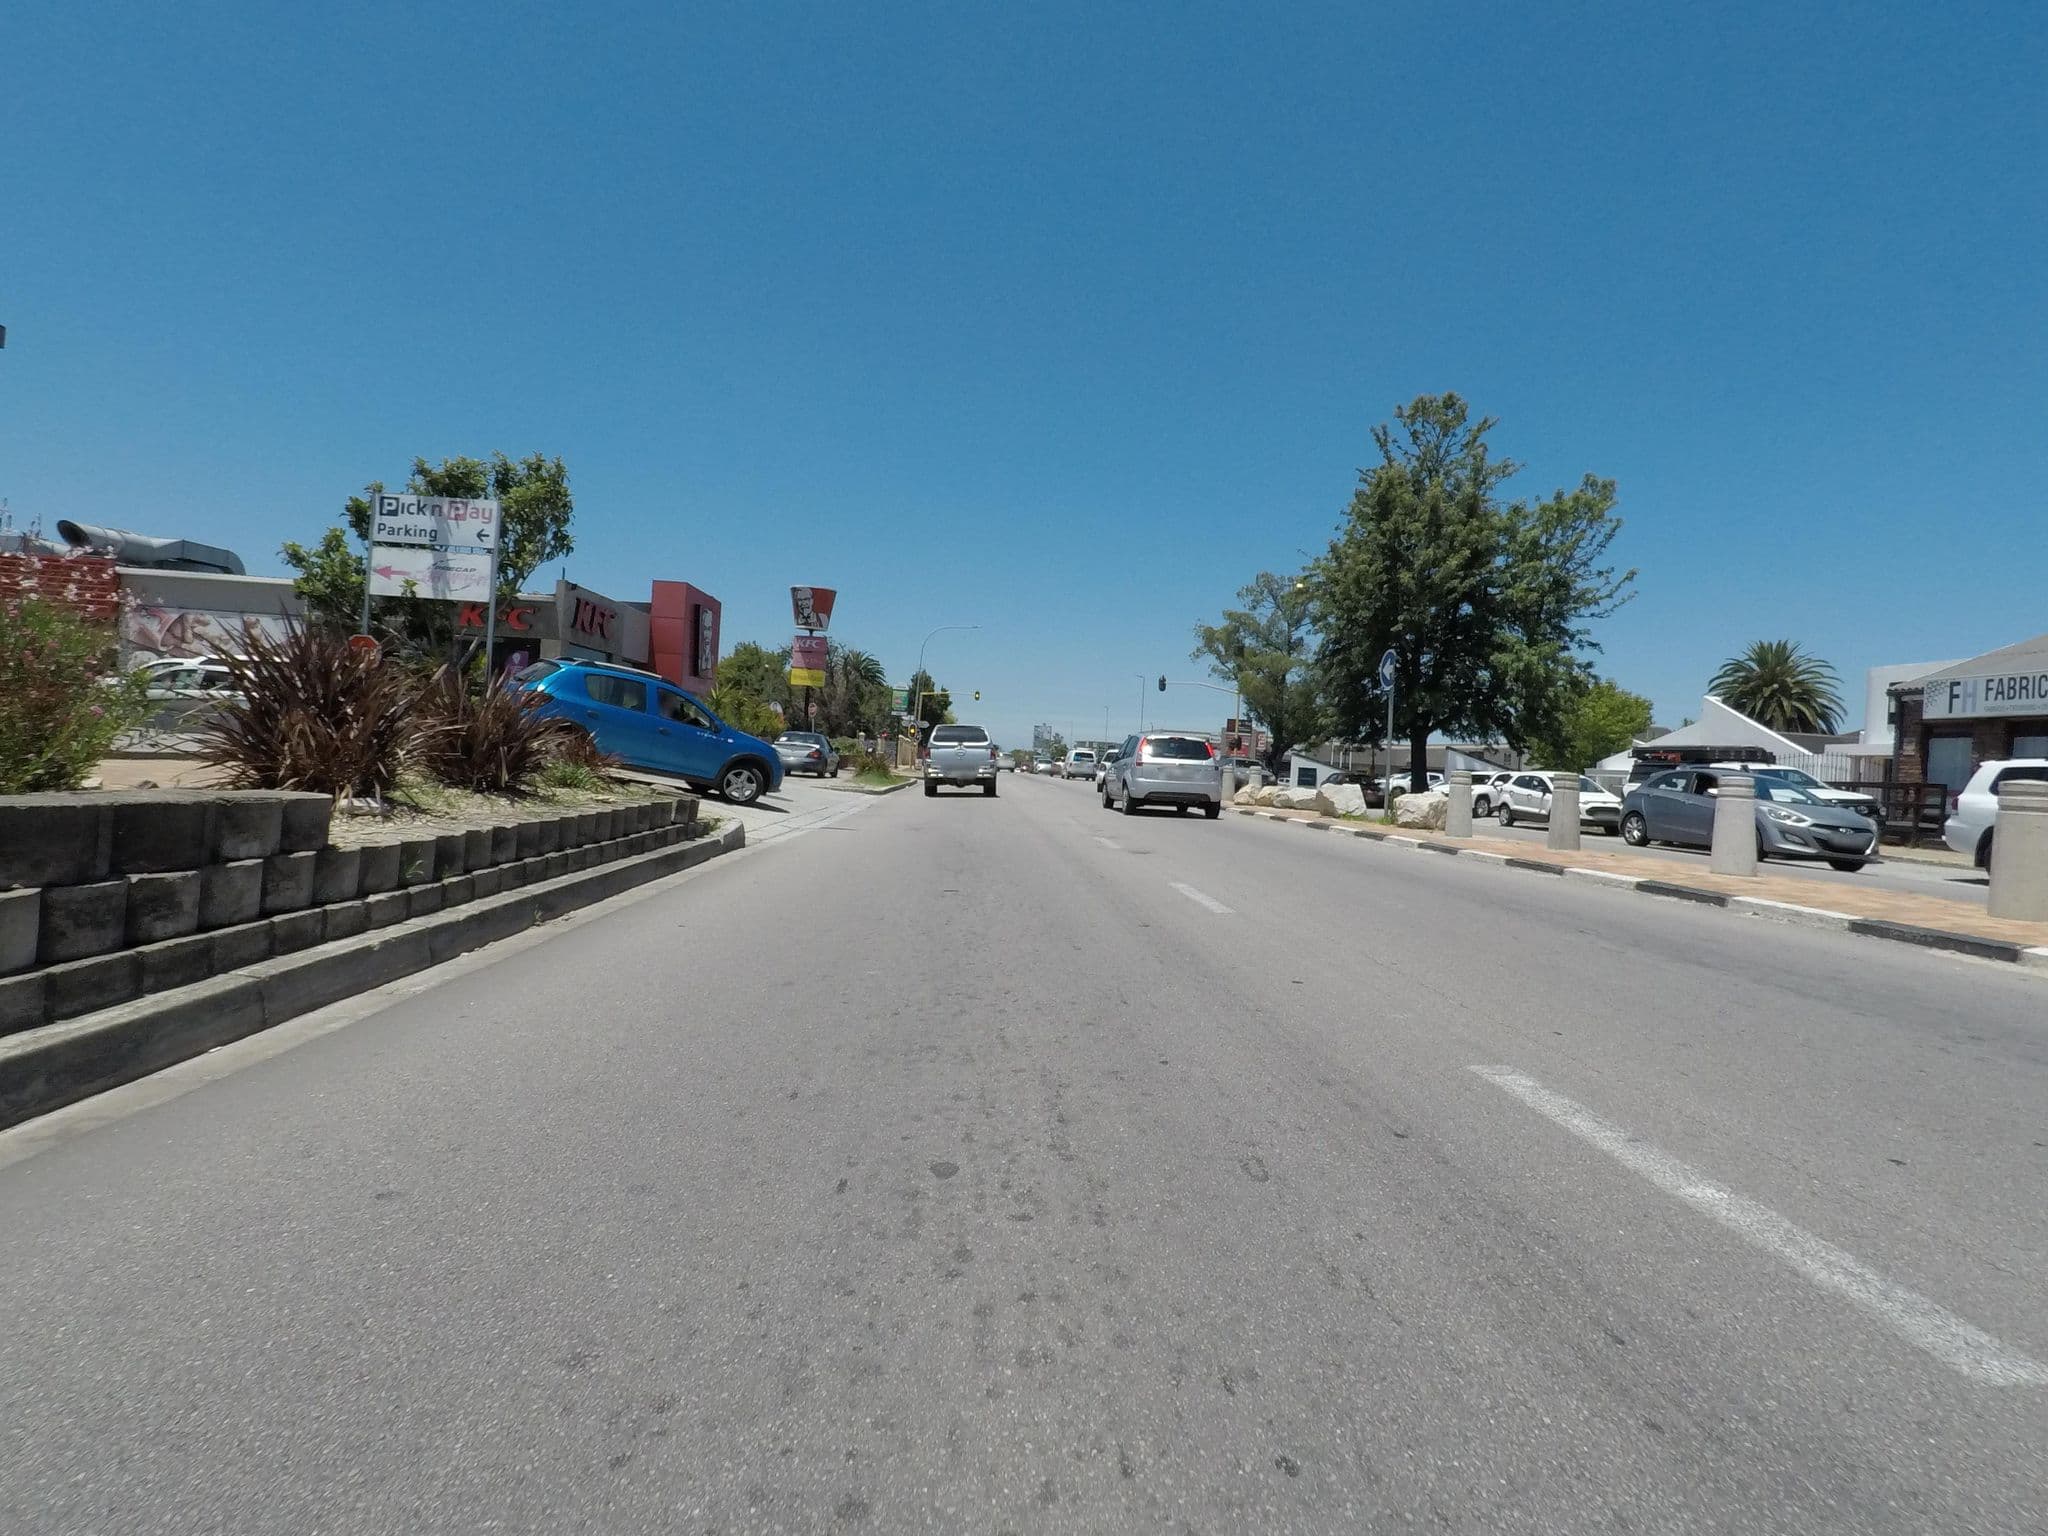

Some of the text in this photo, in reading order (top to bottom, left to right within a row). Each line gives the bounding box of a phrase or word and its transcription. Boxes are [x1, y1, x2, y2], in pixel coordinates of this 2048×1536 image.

[379, 496, 427, 516] Pick
[447, 500, 493, 524] Pay
[377, 523, 438, 541] Parking
[796, 639, 821, 649] KFC
[1948, 674, 2048, 714] FH FABRIC
